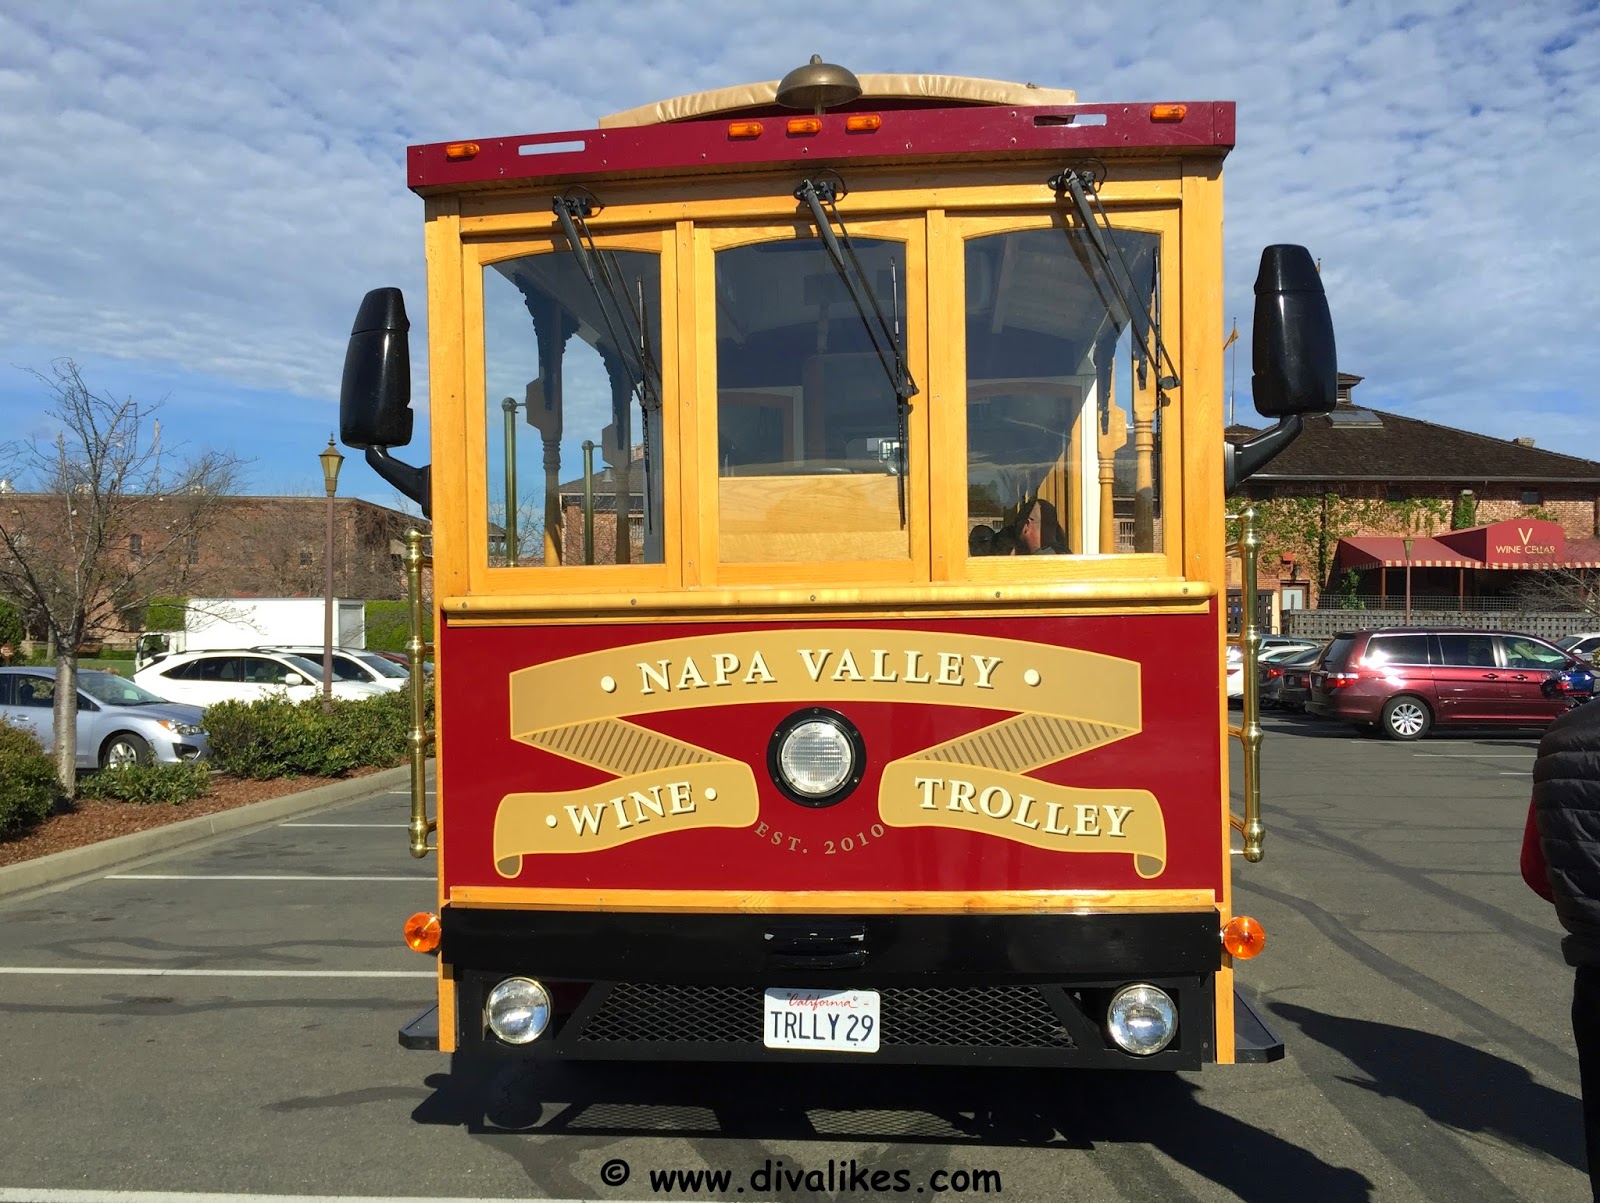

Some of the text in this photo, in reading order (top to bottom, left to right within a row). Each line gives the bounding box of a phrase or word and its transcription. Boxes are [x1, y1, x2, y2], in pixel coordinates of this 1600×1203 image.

[1495, 545, 1556, 555] WINE CELLAR
[1517, 527, 1534, 546] V
[636, 648, 1004, 695] NAPA VALLEY
[563, 781, 697, 837] WINE
[914, 776, 1135, 838] TROLLEY
[754, 821, 885, 855] EST. 2010
[787, 992, 859, 1012] California
[770, 1010, 875, 1042] TRLLY 29
